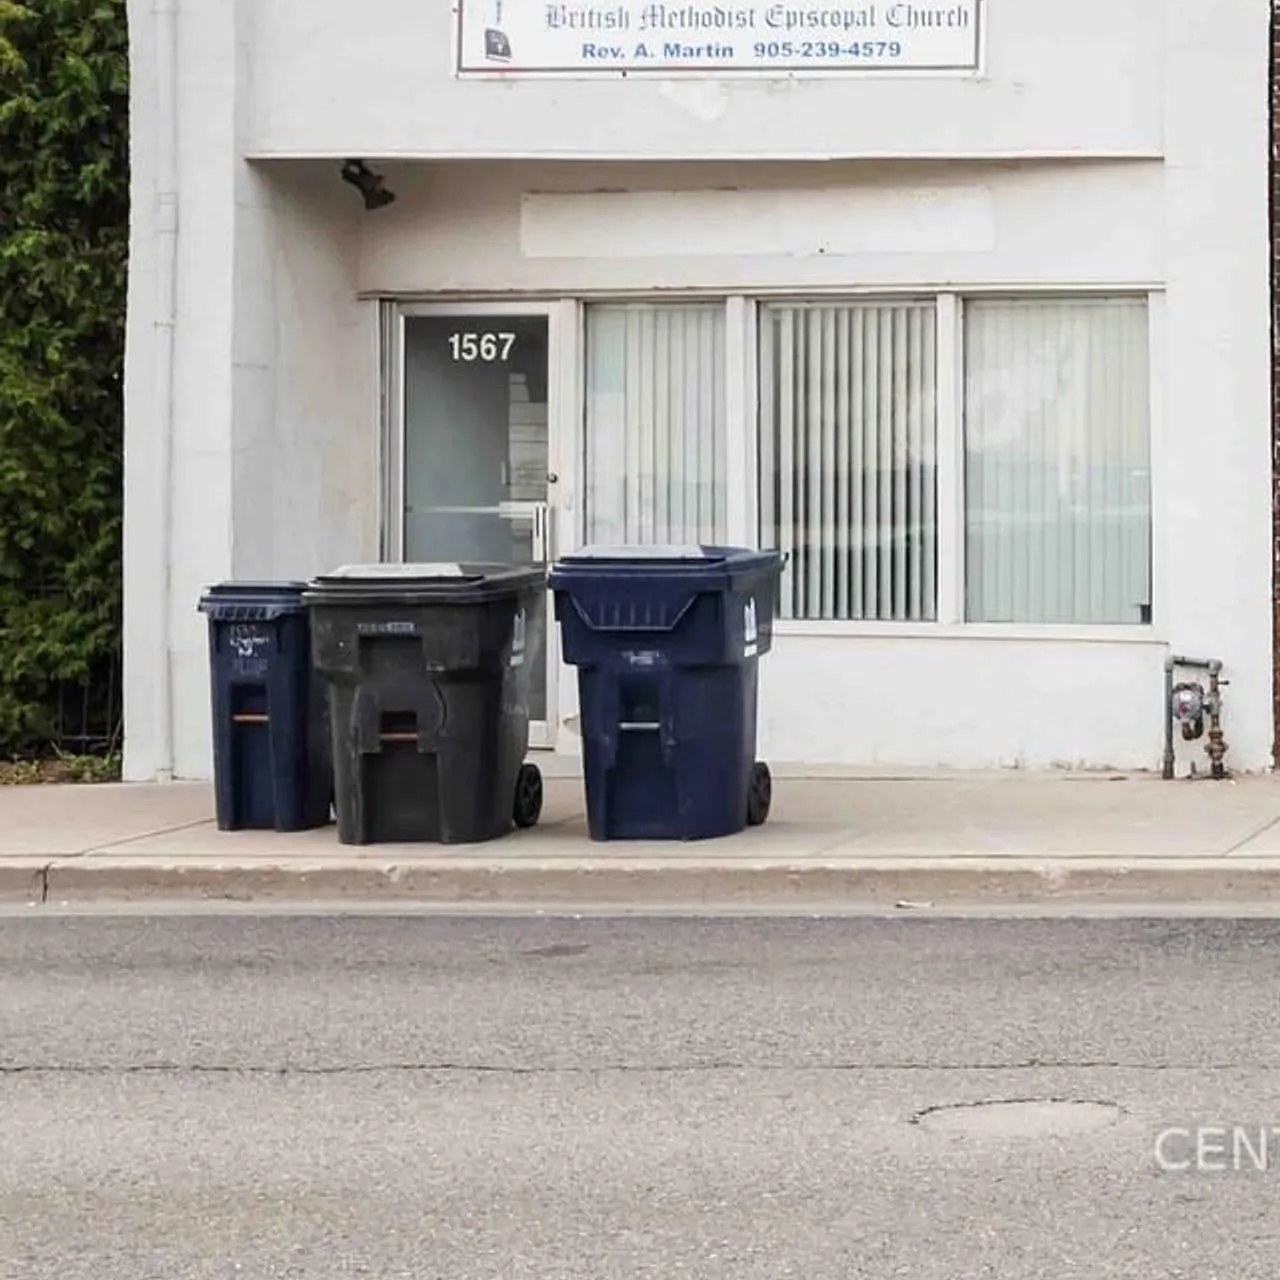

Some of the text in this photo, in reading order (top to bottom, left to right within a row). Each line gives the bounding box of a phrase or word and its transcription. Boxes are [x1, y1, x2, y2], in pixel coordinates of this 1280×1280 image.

[545, 3, 969, 31] British Methodist Episcopal Church
[582, 41, 902, 59] Rev. A. Martin 905-239-4579
[447, 332, 516, 361] 1567
